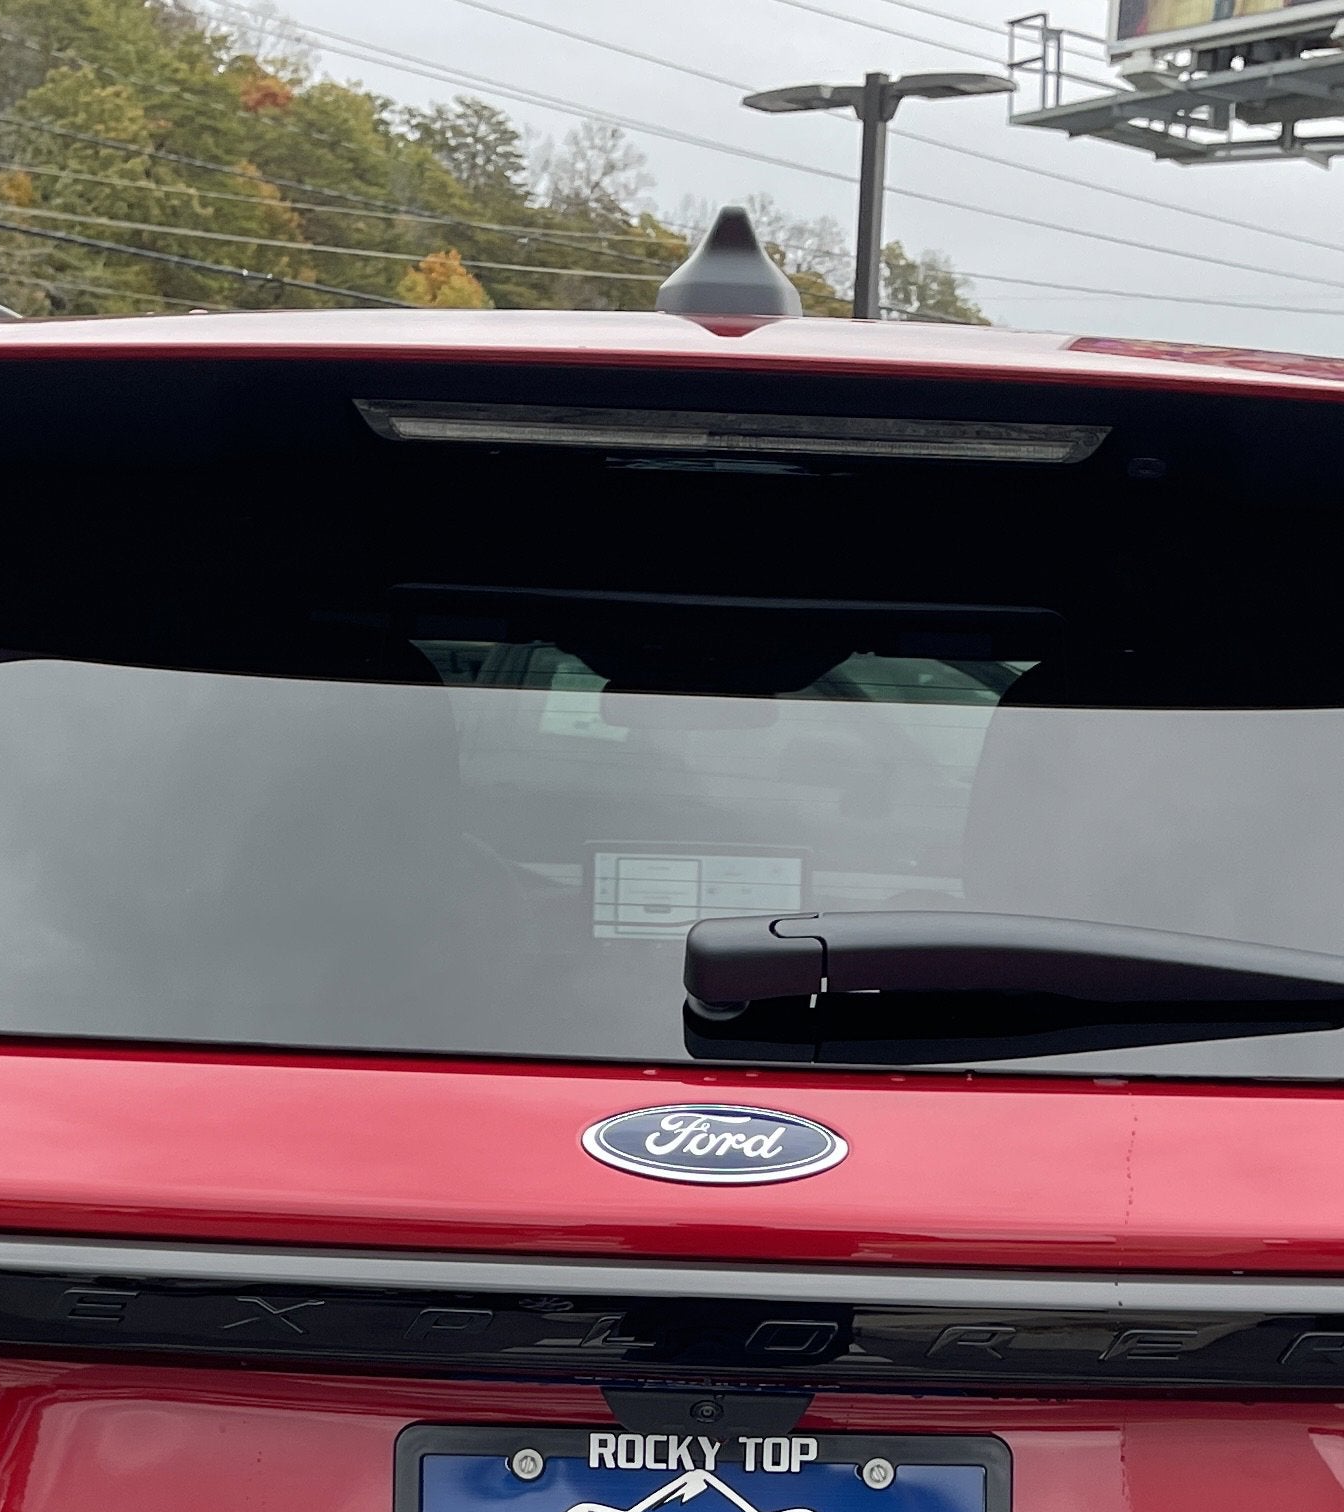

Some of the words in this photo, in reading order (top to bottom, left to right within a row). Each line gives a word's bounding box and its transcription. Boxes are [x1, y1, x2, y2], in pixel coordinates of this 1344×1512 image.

[645, 1112, 783, 1158] Ford
[589, 1433, 721, 1471] ROCKY
[738, 1436, 818, 1473] TOP
